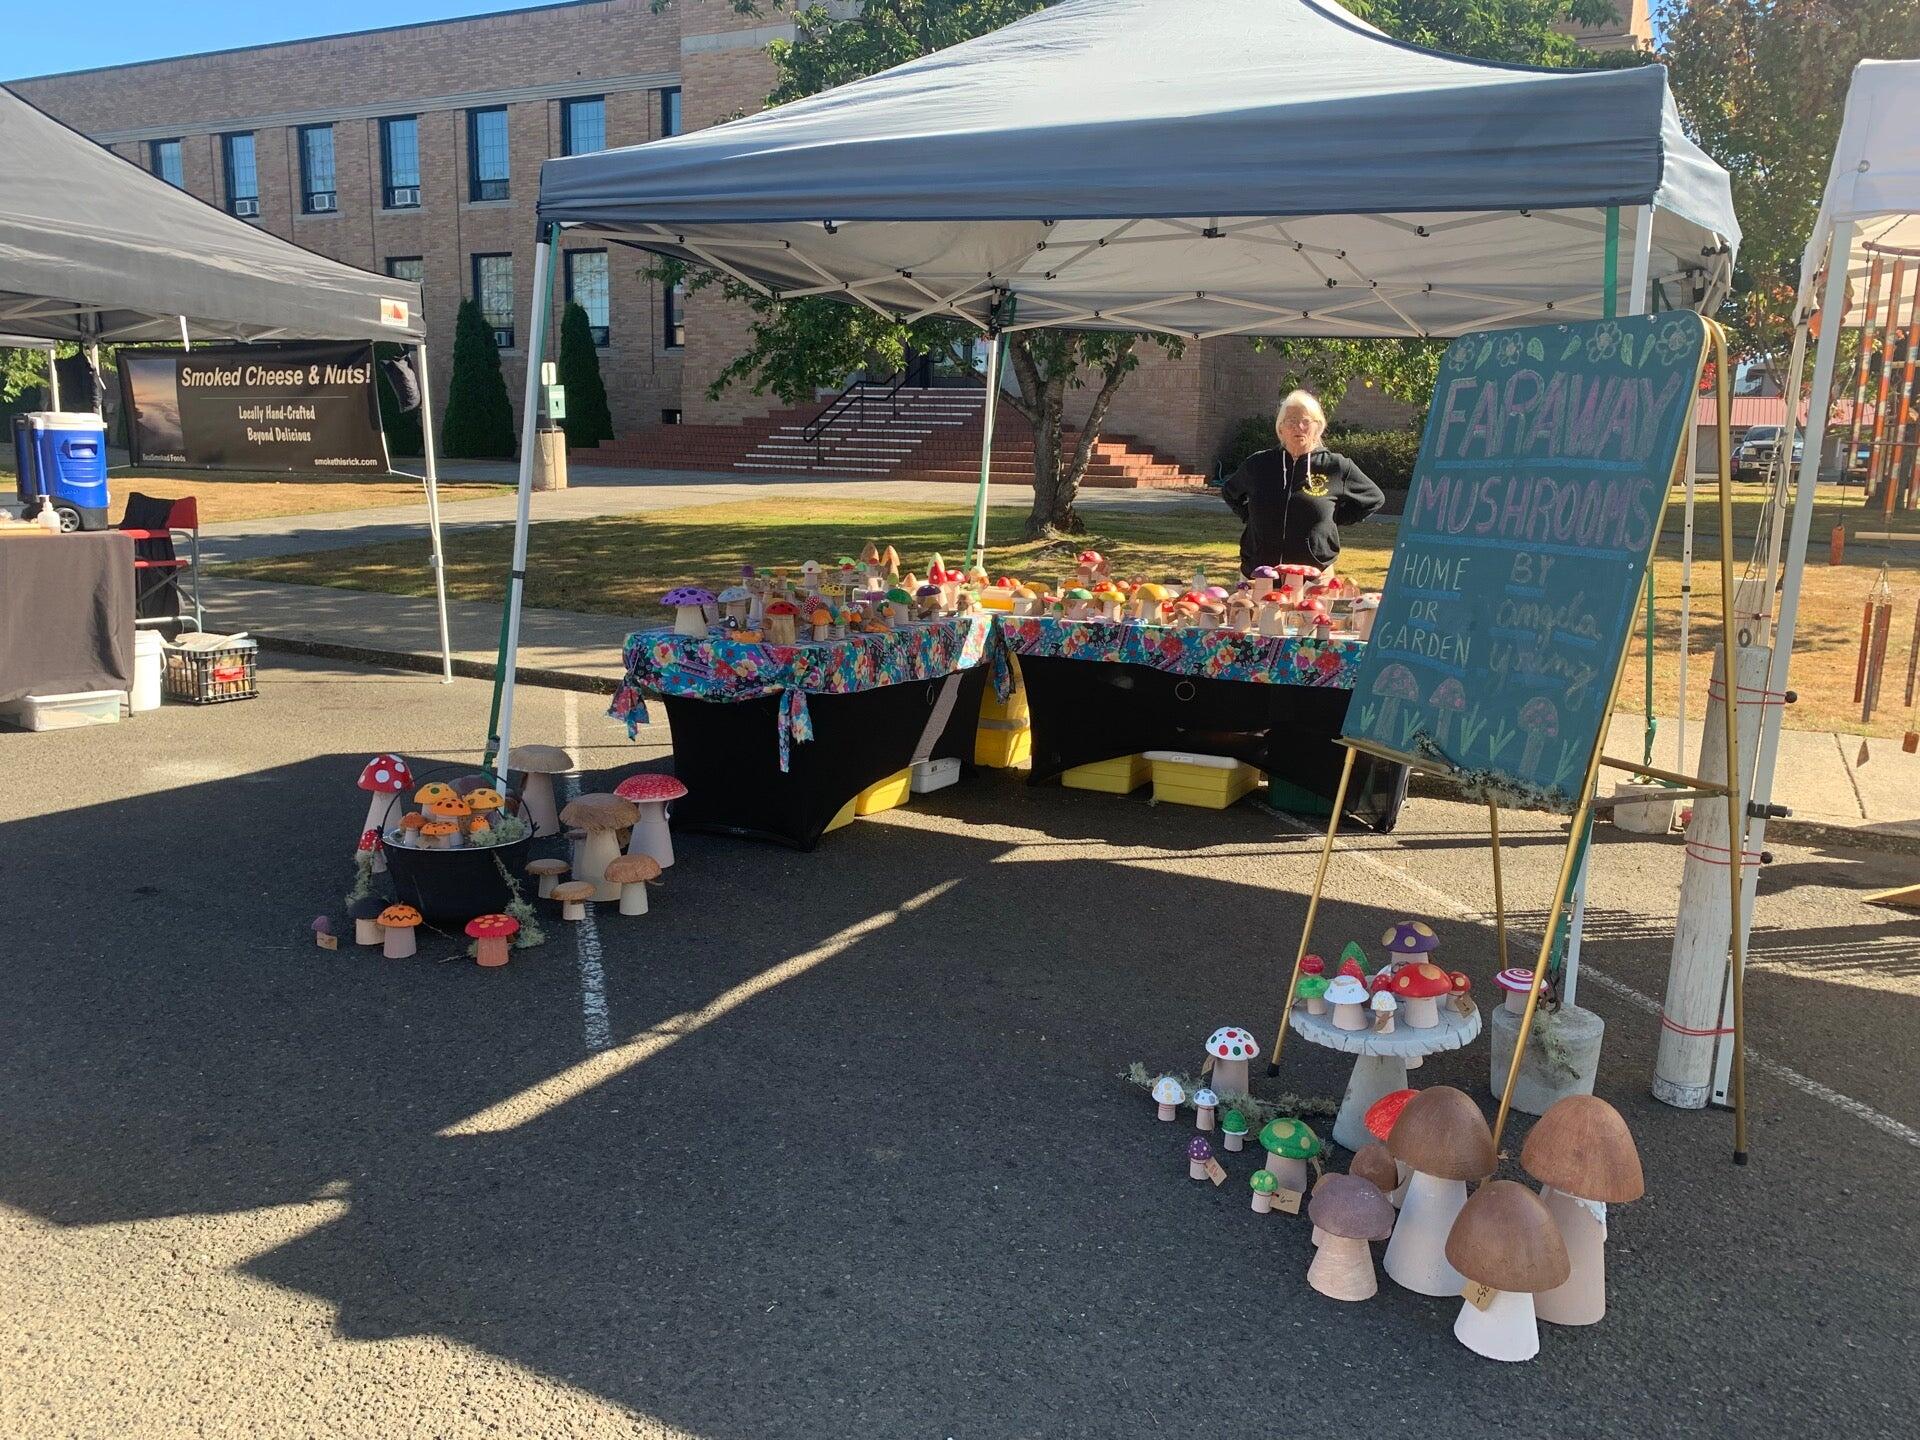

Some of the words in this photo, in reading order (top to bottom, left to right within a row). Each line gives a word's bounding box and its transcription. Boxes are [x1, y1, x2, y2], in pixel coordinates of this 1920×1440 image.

[181, 366, 242, 387] Smoked
[245, 365, 304, 386] Cheese
[308, 364, 320, 386] &
[323, 362, 372, 385] Nuts!
[238, 405, 264, 423] Locally
[265, 405, 316, 420] Hand-Crafted
[1434, 368, 1683, 459] FARAWAY
[247, 427, 274, 445] Beyond
[276, 428, 312, 442] Delicious
[314, 457, 378, 466] smokethisrick.com
[1410, 475, 1658, 552] MUSHROOMS
[1401, 553, 1471, 591] HOME
[1511, 551, 1555, 585] BY
[1409, 600, 1439, 622] OR
[1377, 621, 1472, 668] GARDEN
